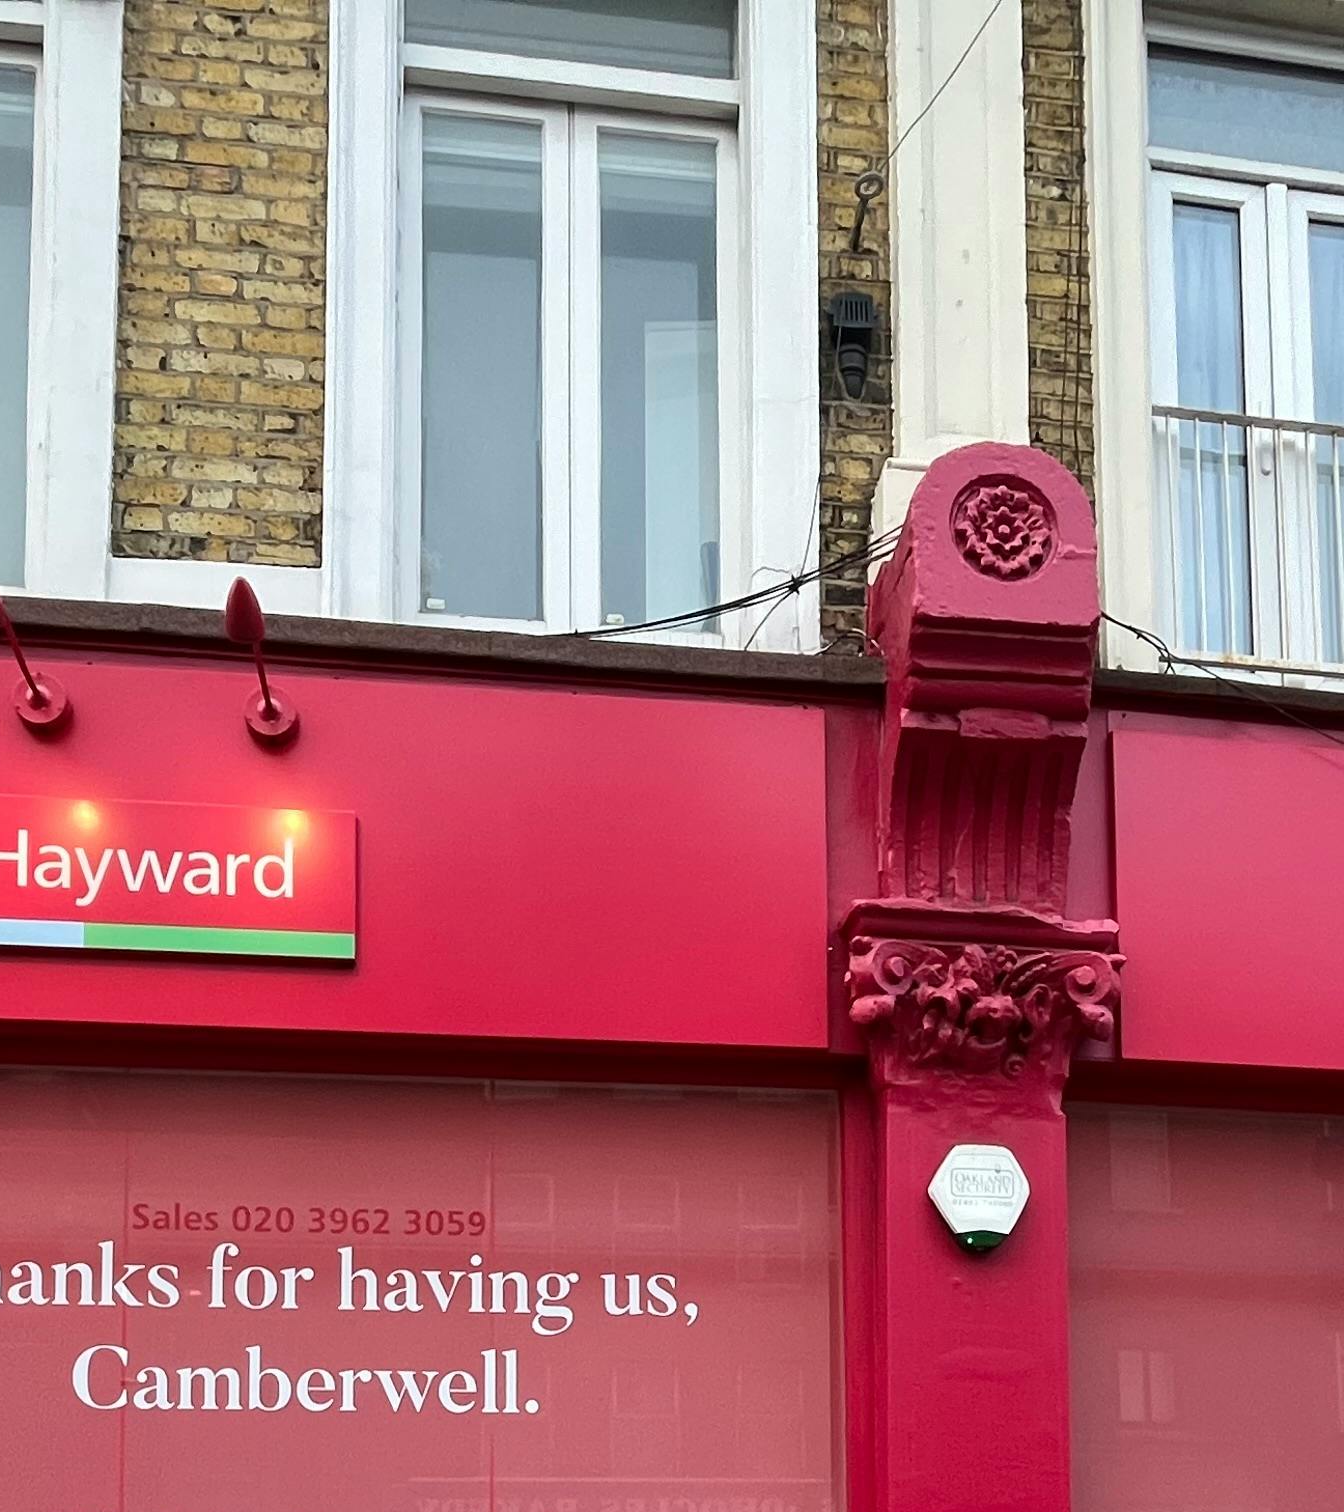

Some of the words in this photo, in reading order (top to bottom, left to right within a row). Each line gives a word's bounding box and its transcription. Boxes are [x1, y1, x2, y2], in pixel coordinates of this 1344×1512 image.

[131, 1202, 219, 1231] Sales
[231, 1205, 295, 1233] 020
[308, 1207, 390, 1235] 3962
[403, 1208, 486, 1236] 3059
[206, 1242, 315, 1310] for
[337, 1246, 580, 1336] having
[600, 1273, 698, 1326] us,
[72, 1344, 539, 1414] Camberwell.
